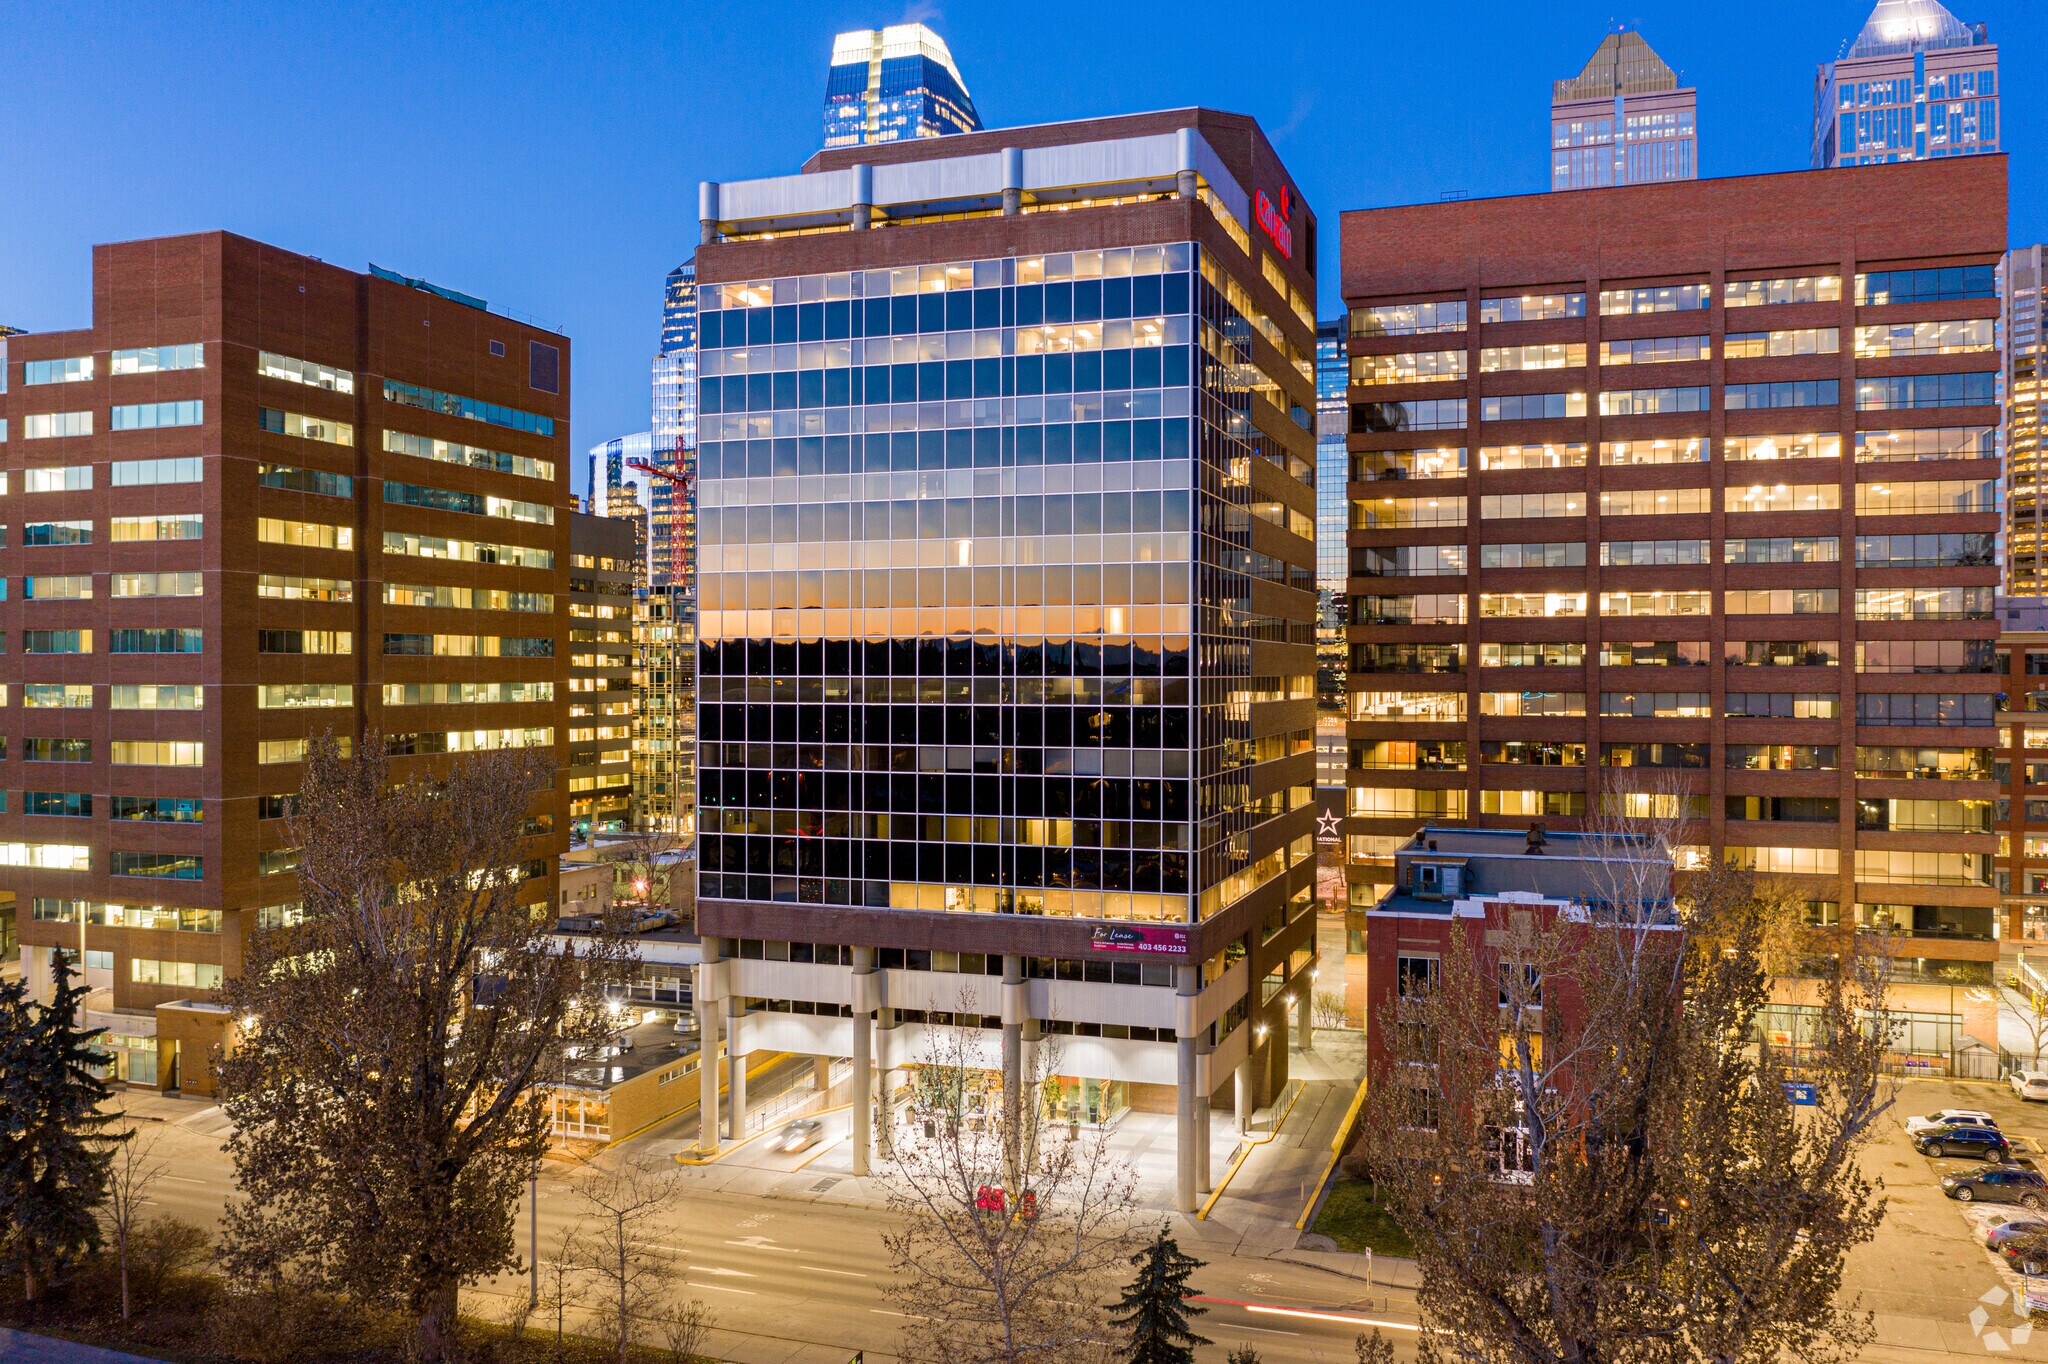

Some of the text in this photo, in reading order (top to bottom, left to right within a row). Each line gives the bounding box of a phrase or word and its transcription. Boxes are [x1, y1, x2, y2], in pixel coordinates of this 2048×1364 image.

[1094, 928, 1134, 940] For Lease
[1138, 943, 1152, 951] 403
[1153, 944, 1167, 952] 456
